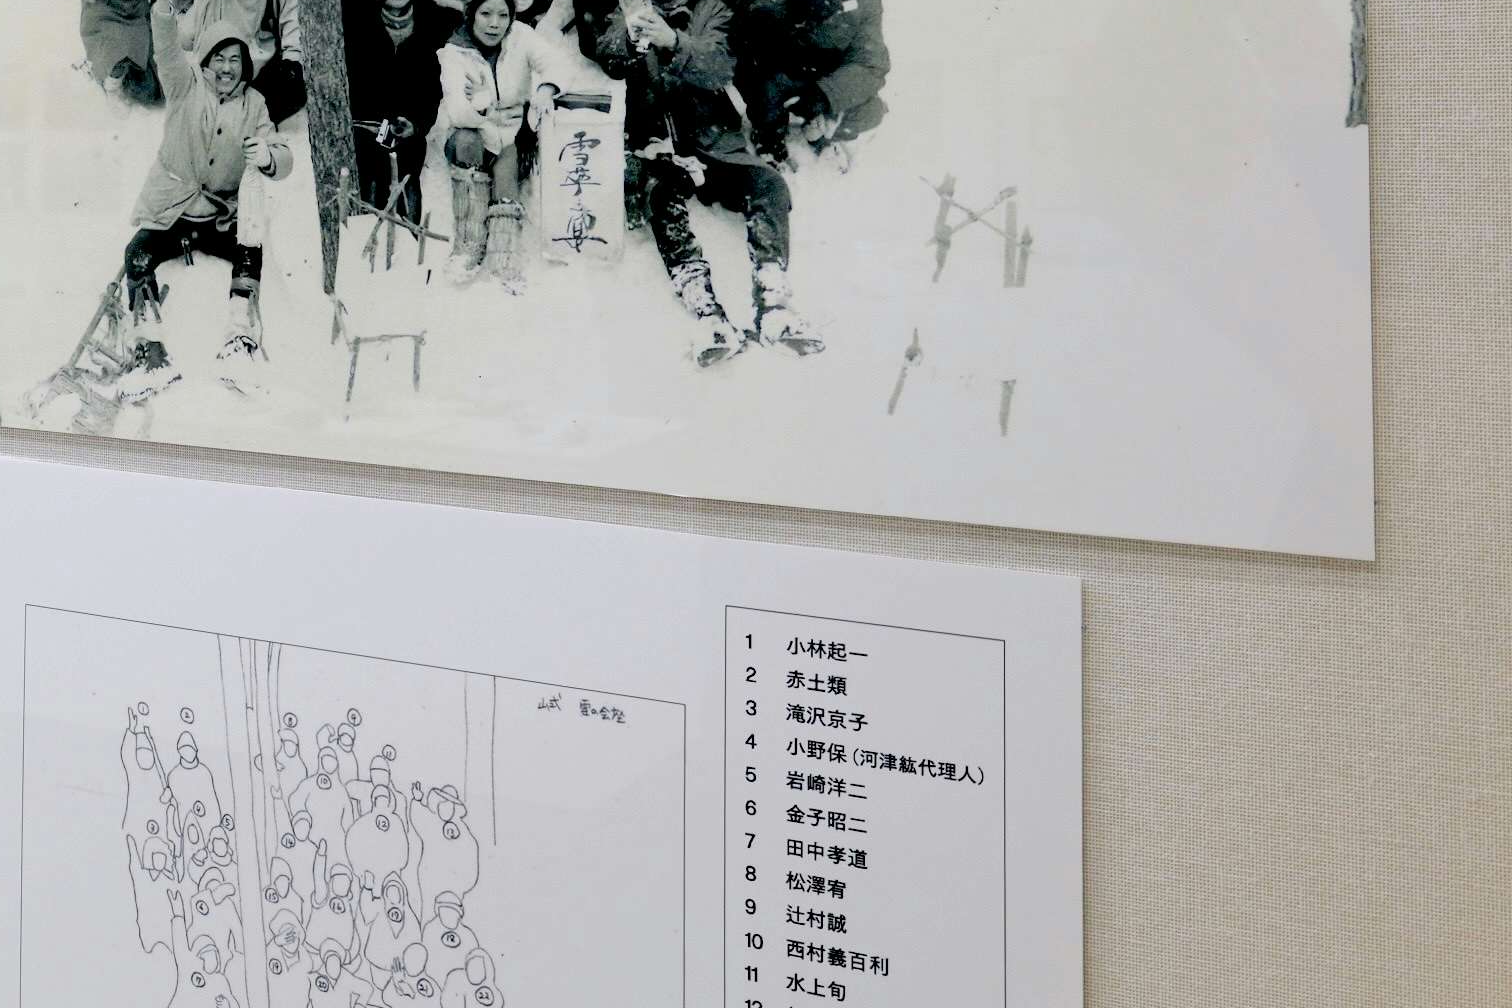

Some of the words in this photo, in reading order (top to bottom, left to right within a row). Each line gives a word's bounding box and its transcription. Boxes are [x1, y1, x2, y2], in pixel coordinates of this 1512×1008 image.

[746, 634, 752, 649] 1
[787, 638, 868, 661] 小林起一
[745, 667, 757, 683] 2
[787, 670, 848, 696] 赤土類
[745, 700, 757, 716] 3
[786, 703, 869, 731] 滝沢京子
[745, 733, 757, 749] 4
[745, 767, 756, 783] 5
[787, 771, 868, 799] 岩崎洋二
[745, 800, 756, 816] 6
[787, 805, 868, 833] 金子昭二
[745, 833, 756, 849] 7
[787, 839, 868, 869] 田中孝道
[745, 866, 757, 882] 8
[786, 871, 847, 900] 松澤宥
[745, 899, 756, 915] 9
[786, 905, 848, 934] 辻村誠
[745, 932, 763, 950] 10
[786, 939, 889, 976] 西村義百利
[745, 966, 758, 982] 11
[786, 973, 846, 1002] 水上旬
